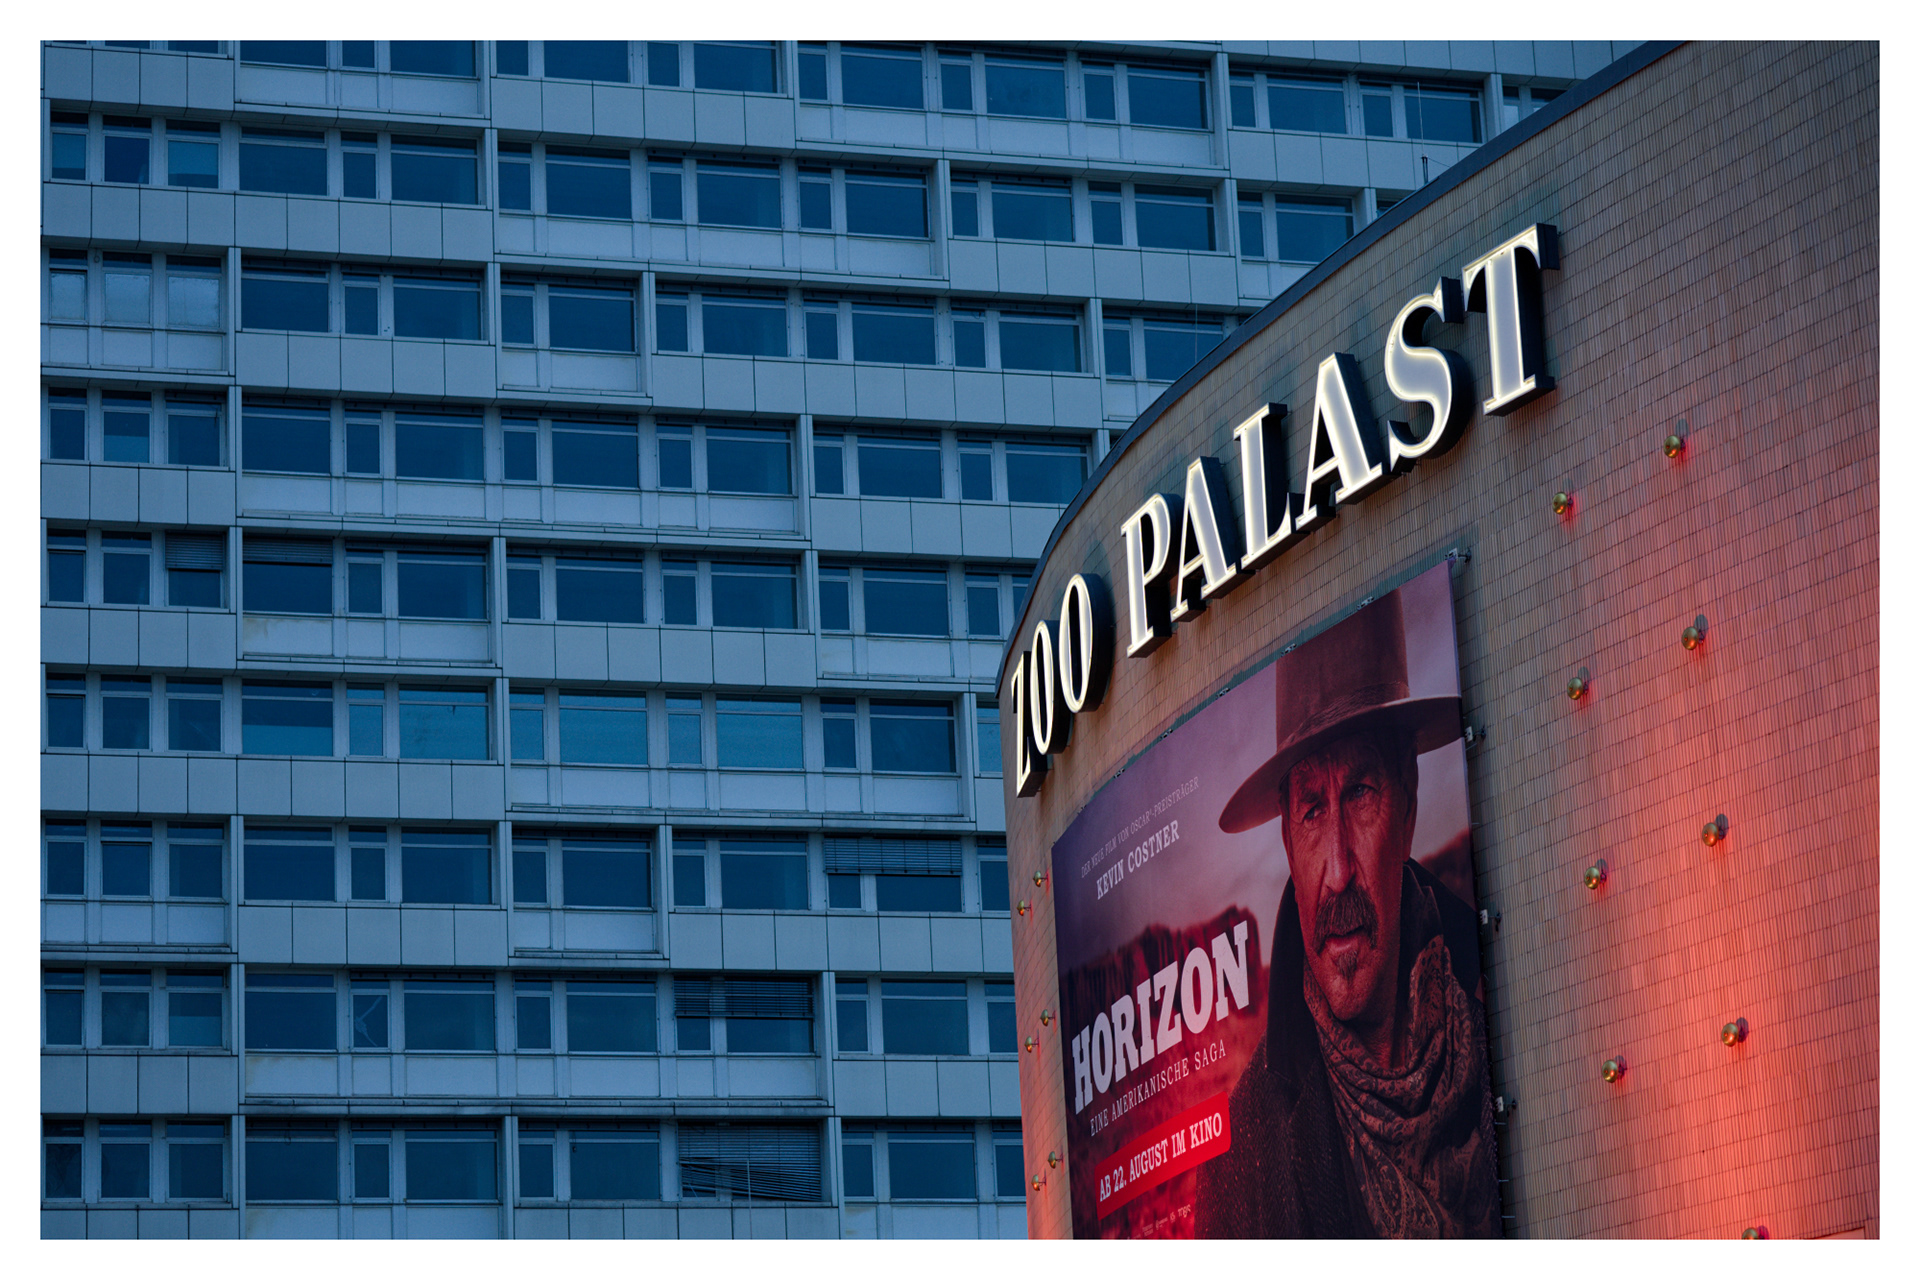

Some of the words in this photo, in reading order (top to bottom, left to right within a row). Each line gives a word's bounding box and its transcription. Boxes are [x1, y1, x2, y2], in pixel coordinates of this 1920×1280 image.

[1011, 573, 1095, 798] ZOO
[1121, 222, 1540, 659] PALAST
[1081, 860, 1091, 879] DER
[1105, 836, 1117, 857] FILM
[1117, 826, 1129, 845] VON
[1096, 859, 1125, 901] KEVIN
[1127, 819, 1180, 874] COSTNER
[1071, 920, 1250, 1116] HORIZON
[1090, 1108, 1109, 1137] EINE
[1111, 1057, 1190, 1122] AMERIKANISCHE
[1194, 1039, 1227, 1071] SAGA
[1099, 1174, 1112, 1203] AB
[1113, 1165, 1127, 1193] 22.
[1129, 1138, 1169, 1184] AUGUST
[1170, 1129, 1187, 1159] IM
[1189, 1112, 1223, 1149] KINO
